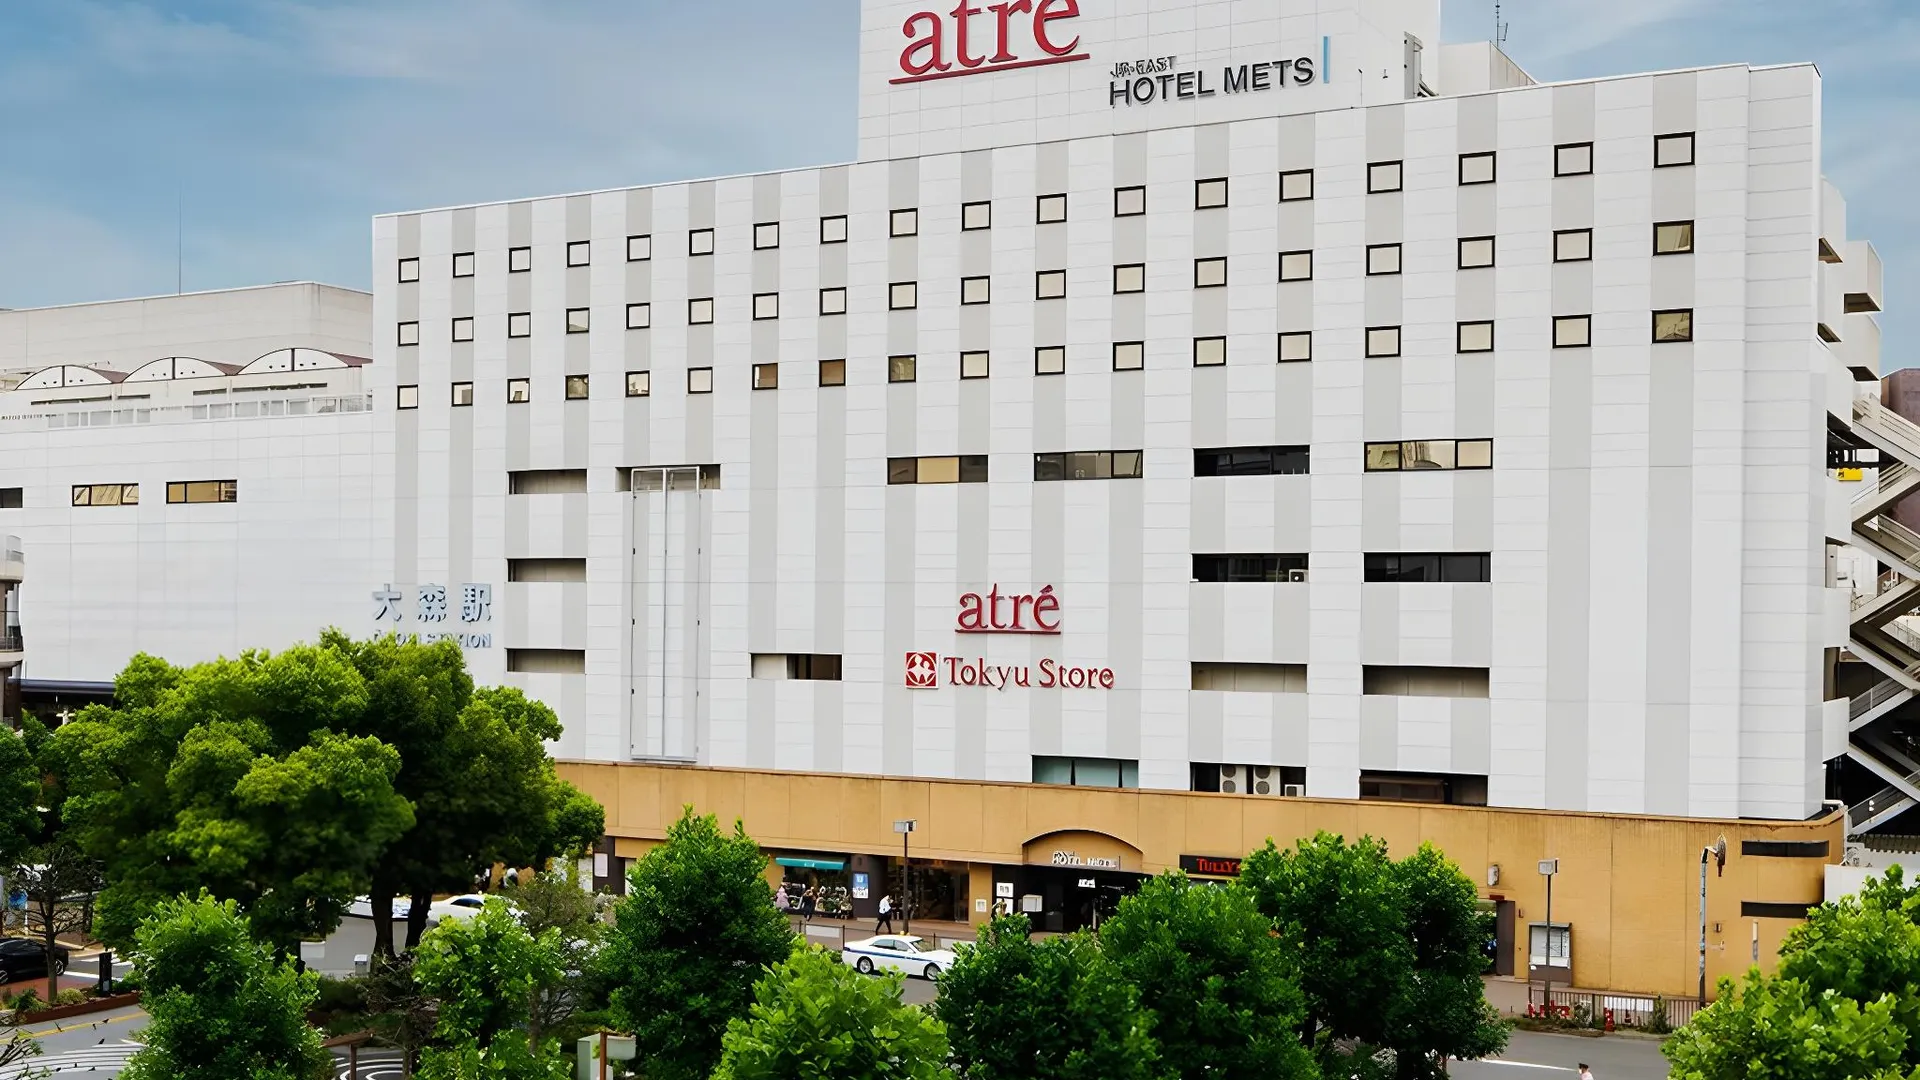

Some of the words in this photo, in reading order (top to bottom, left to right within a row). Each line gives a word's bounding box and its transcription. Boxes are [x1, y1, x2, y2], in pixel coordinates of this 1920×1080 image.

[1110, 70, 1216, 107] HOTEL
[1224, 57, 1316, 94] METS
[957, 583, 1061, 631] atré
[943, 657, 1031, 691] Tokyu
[1038, 658, 1115, 689] Store
